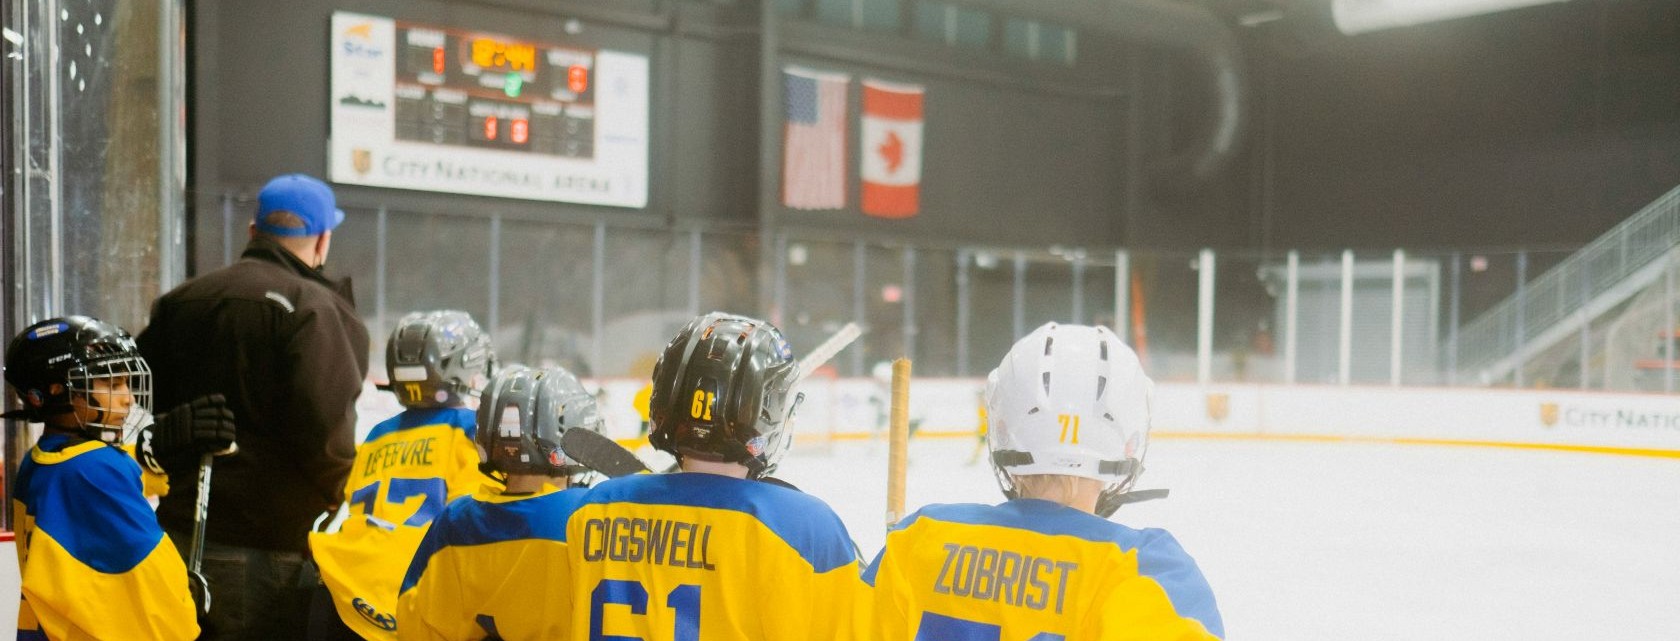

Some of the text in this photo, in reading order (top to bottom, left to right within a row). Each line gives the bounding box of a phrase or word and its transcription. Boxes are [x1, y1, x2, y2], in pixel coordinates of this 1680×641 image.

[691, 389, 715, 421] 61
[1057, 413, 1080, 445] 71
[934, 542, 1079, 615] ZOBRIST
